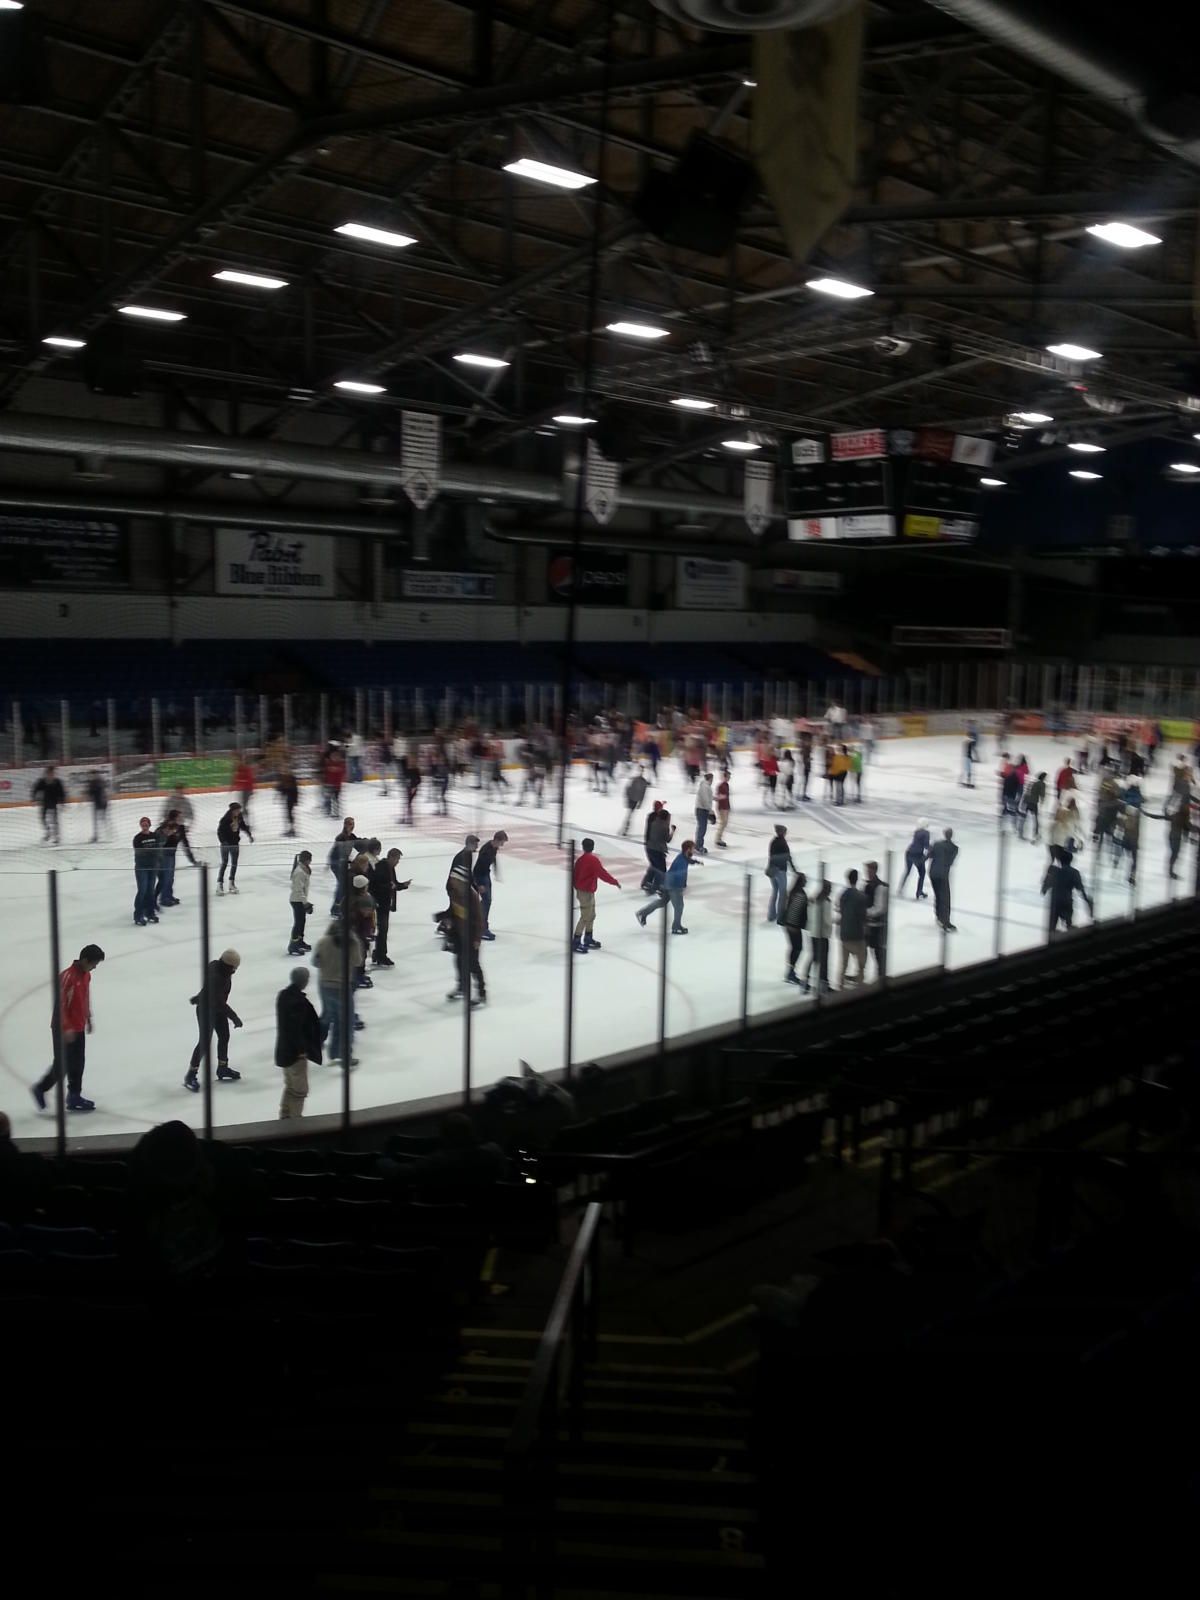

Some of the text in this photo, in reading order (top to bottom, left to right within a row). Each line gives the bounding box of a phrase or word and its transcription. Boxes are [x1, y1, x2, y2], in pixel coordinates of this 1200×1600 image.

[248, 529, 304, 562] Pabst
[229, 563, 322, 586] Blue Ribbon
